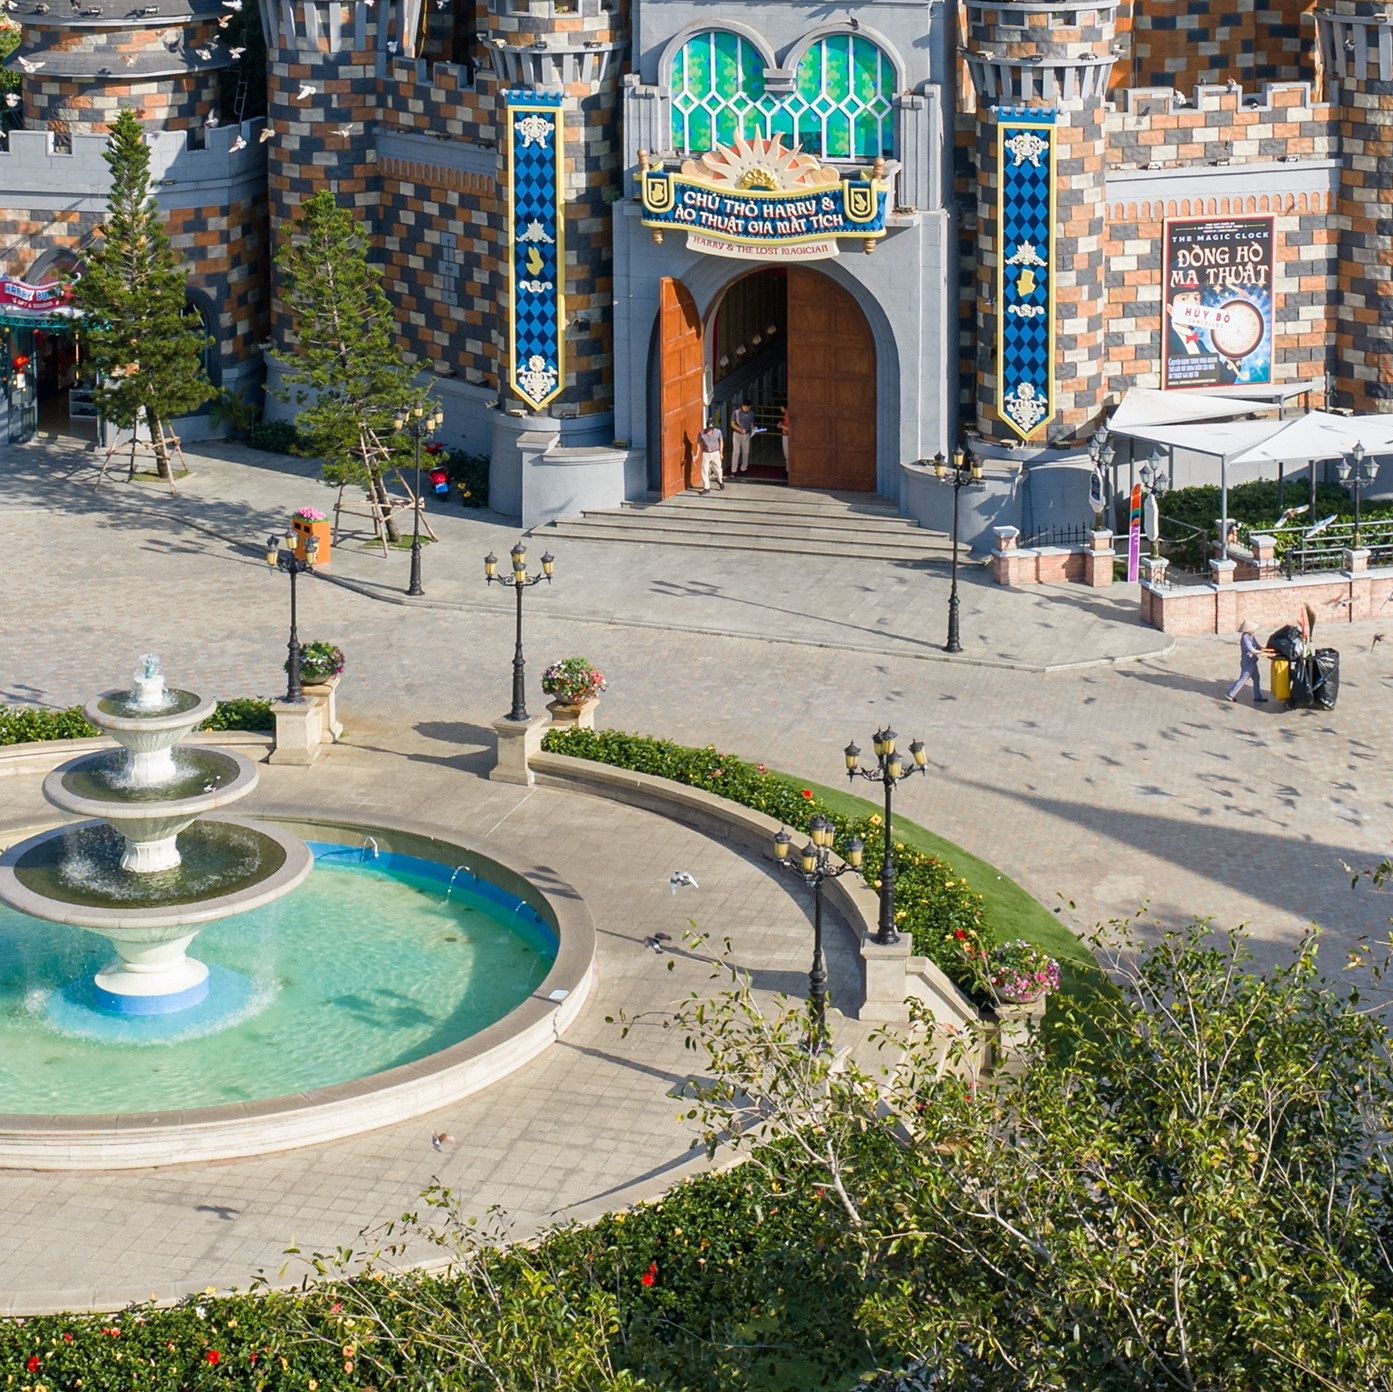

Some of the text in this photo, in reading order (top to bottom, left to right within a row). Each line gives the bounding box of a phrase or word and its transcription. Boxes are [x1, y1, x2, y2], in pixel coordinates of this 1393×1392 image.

[683, 191, 835, 218] CHÚ THỎ HARRY &
[675, 203, 696, 221] ẢO
[700, 211, 745, 235] THUẬT
[747, 220, 774, 234] GIA
[810, 213, 844, 229] TÍCH
[693, 236, 829, 255] HARRY & THE LOST MAGICIAN
[1171, 235, 1192, 243] THE
[1197, 233, 1230, 241] MAGIC
[1177, 241, 1263, 268] ĐỒNG HỒ
[1170, 269, 1200, 287] MA
[4, 283, 35, 301] HARRY
